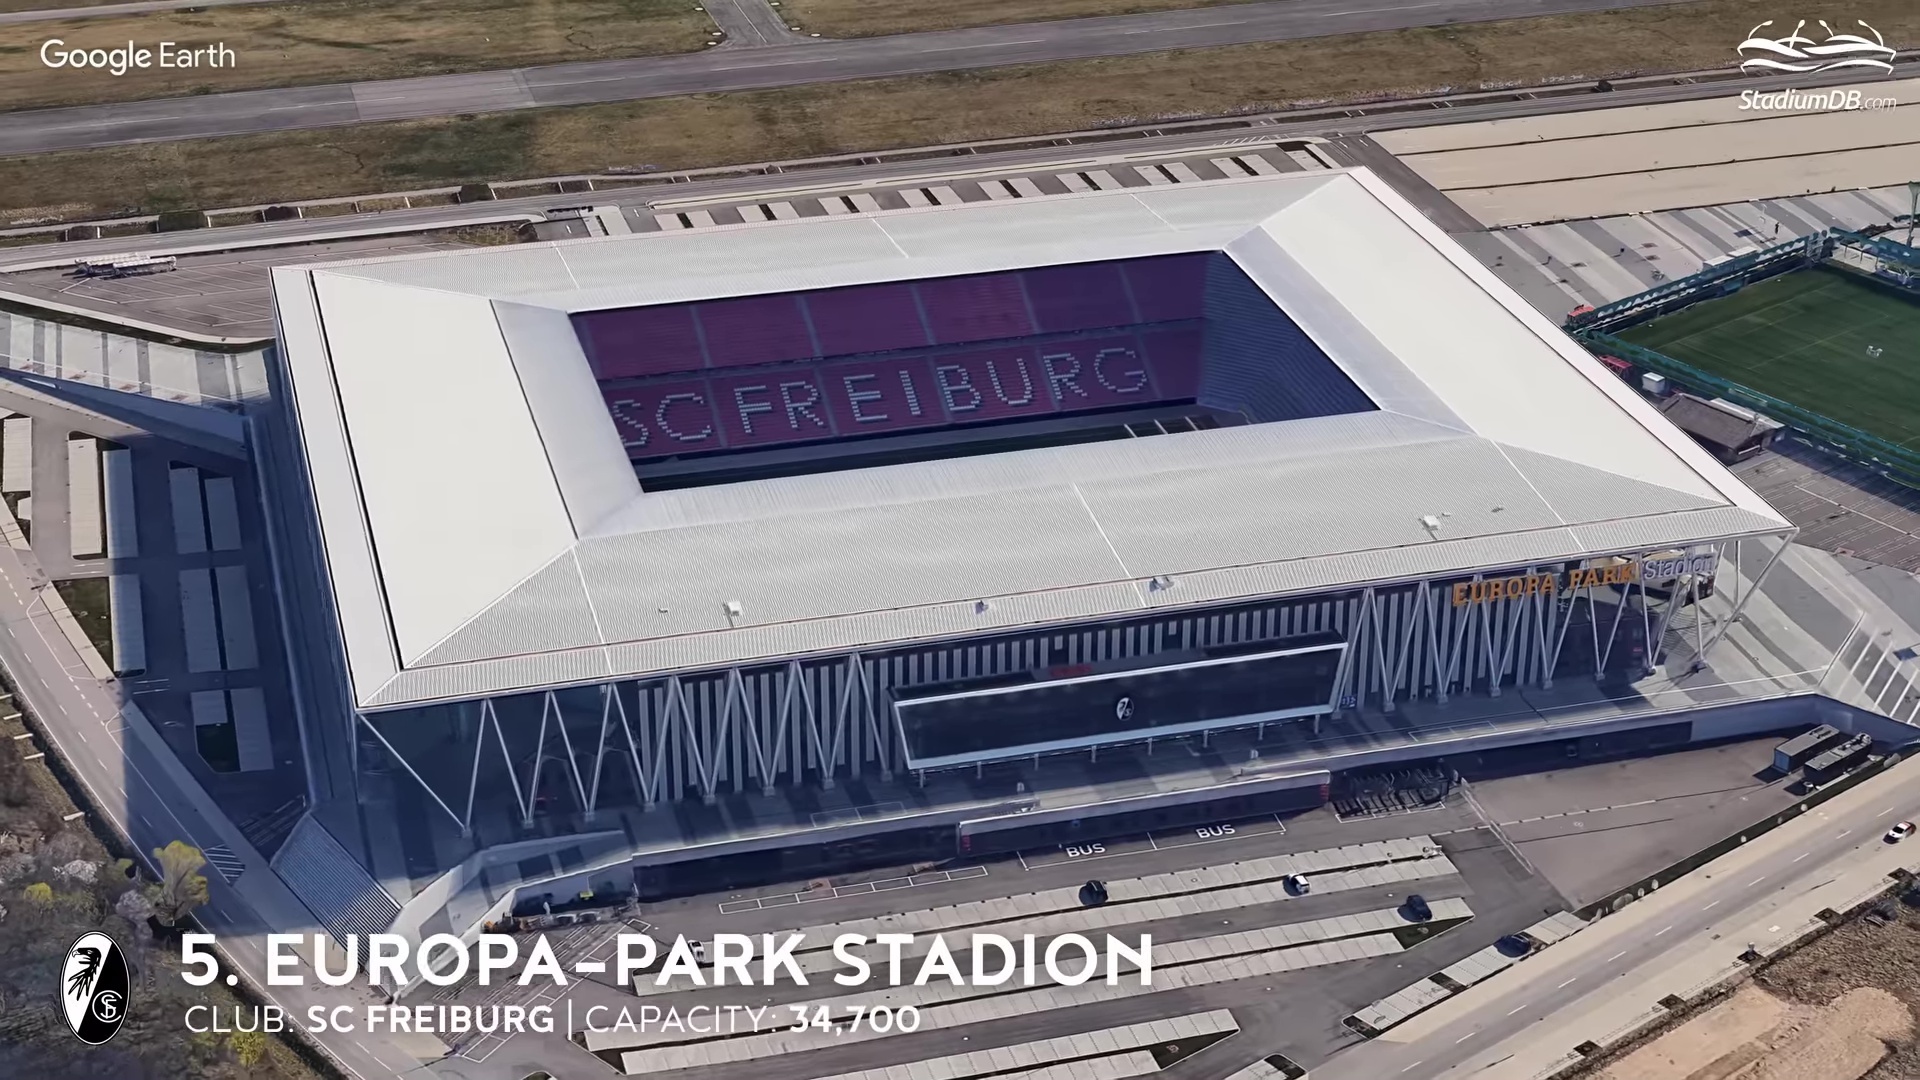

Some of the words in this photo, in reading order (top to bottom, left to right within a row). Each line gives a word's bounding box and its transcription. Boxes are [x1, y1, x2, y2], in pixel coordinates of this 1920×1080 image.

[612, 392, 712, 447] SC
[734, 347, 1147, 434] FREIBURG
[1453, 572, 1554, 607] EUROPA
[1569, 562, 1637, 591] PARK
[1643, 552, 1717, 581] Stadion
[1194, 823, 1236, 840] BUS
[1065, 842, 1107, 859] BUS
